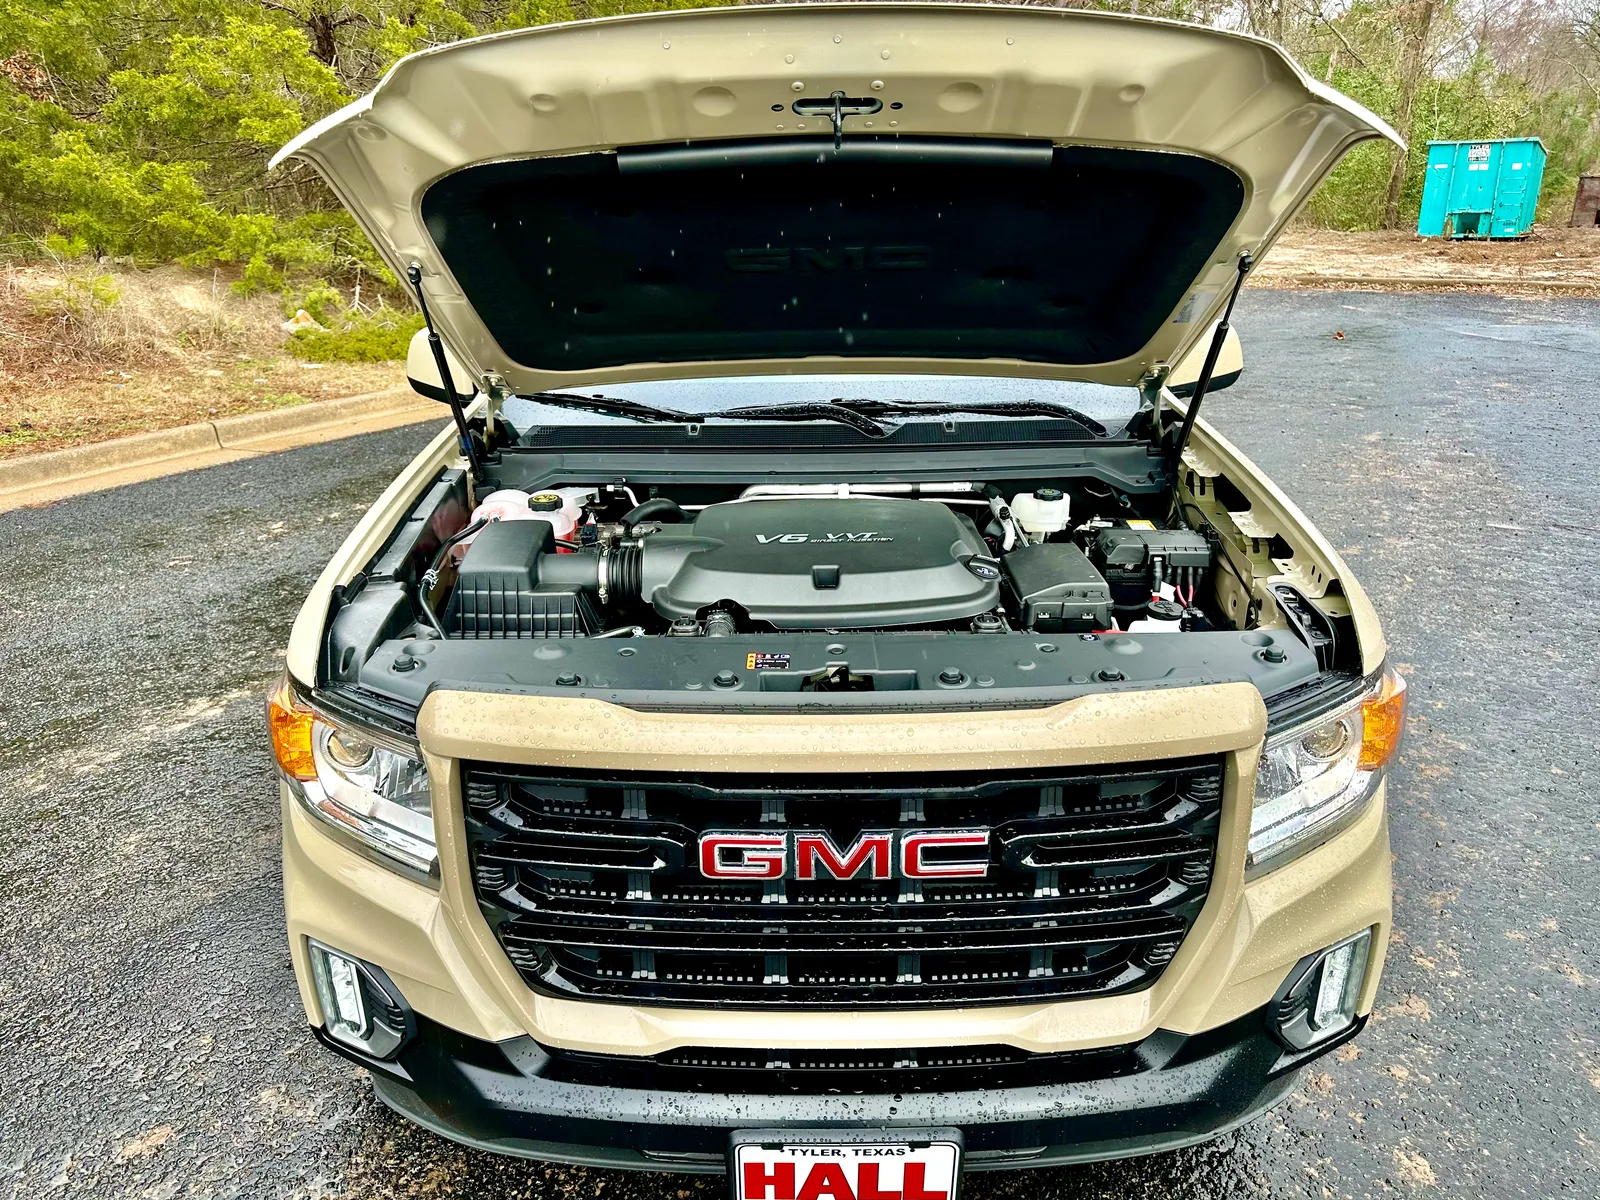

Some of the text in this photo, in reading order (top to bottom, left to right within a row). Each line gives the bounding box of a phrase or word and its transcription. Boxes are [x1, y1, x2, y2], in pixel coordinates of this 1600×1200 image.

[755, 532, 878, 544] V6 VVT
[698, 829, 990, 880] GMC
[788, 1148, 906, 1158] TYLER, TEXAS
[744, 1162, 948, 1200] HALL
